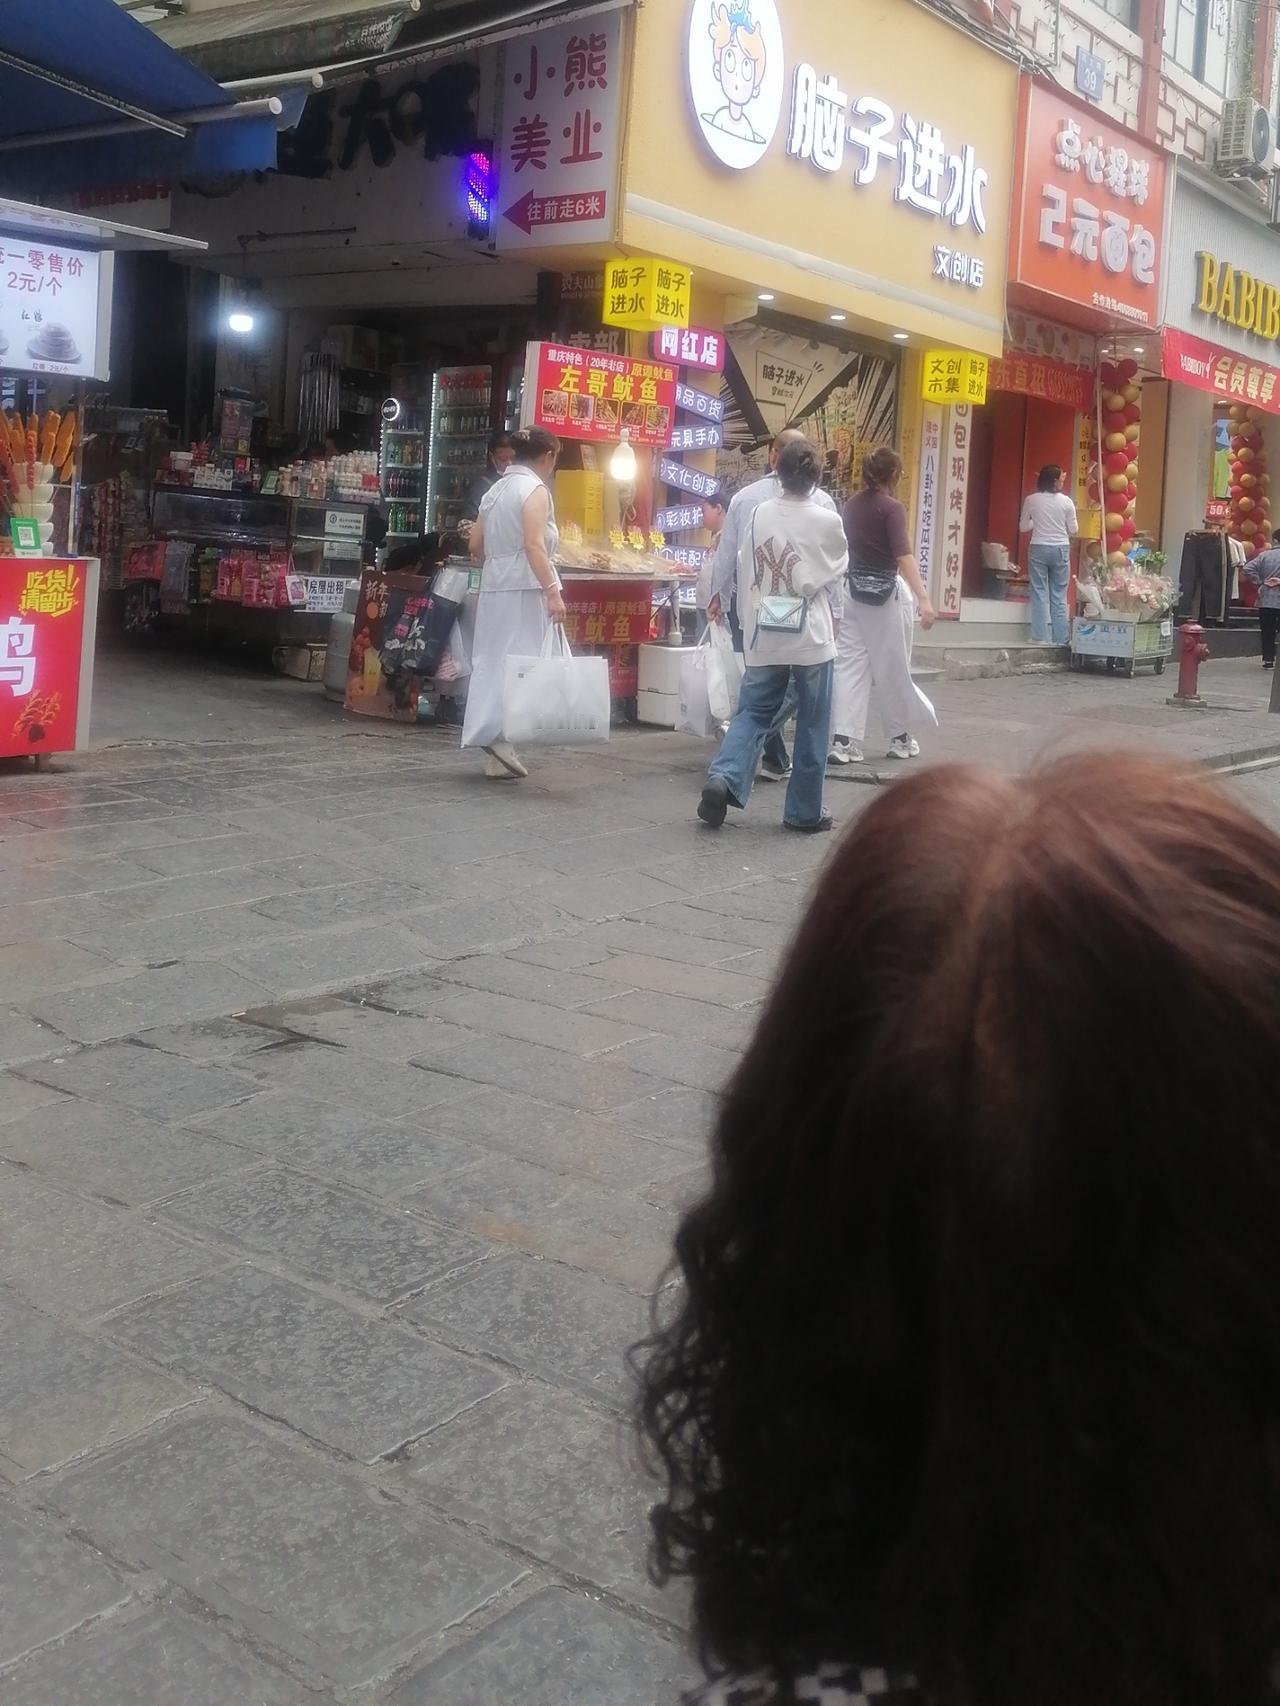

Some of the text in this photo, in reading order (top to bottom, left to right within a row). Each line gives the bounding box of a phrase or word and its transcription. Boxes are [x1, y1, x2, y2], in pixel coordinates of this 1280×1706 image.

[513, 33, 607, 100] 小熊
[511, 109, 603, 172] 美业
[787, 63, 988, 234] 脑子进水
[527, 196, 600, 221] 往前走6米
[1040, 184, 1154, 284] 2元面包
[611, 267, 646, 290] 脑子
[932, 245, 983, 288] 文创店
[7, 272, 63, 296] 2元/个
[656, 268, 686, 292] 脑子
[610, 293, 645, 315] 进水
[656, 294, 684, 319] 进水
[661, 328, 720, 366] 网红店
[763, 364, 805, 387] 脑子进水
[931, 358, 961, 375] 文创
[969, 359, 985, 378] 脑子
[559, 365, 658, 404] 左哥鱿鱼
[928, 377, 961, 393] 市集
[968, 379, 983, 397] 进水
[1214, 355, 1277, 404] 会员尊享
[667, 464, 717, 496] 文化创意
[755, 536, 801, 594] NY
[309, 580, 345, 594] 房屋出租
[21, 589, 76, 617] 请留步
